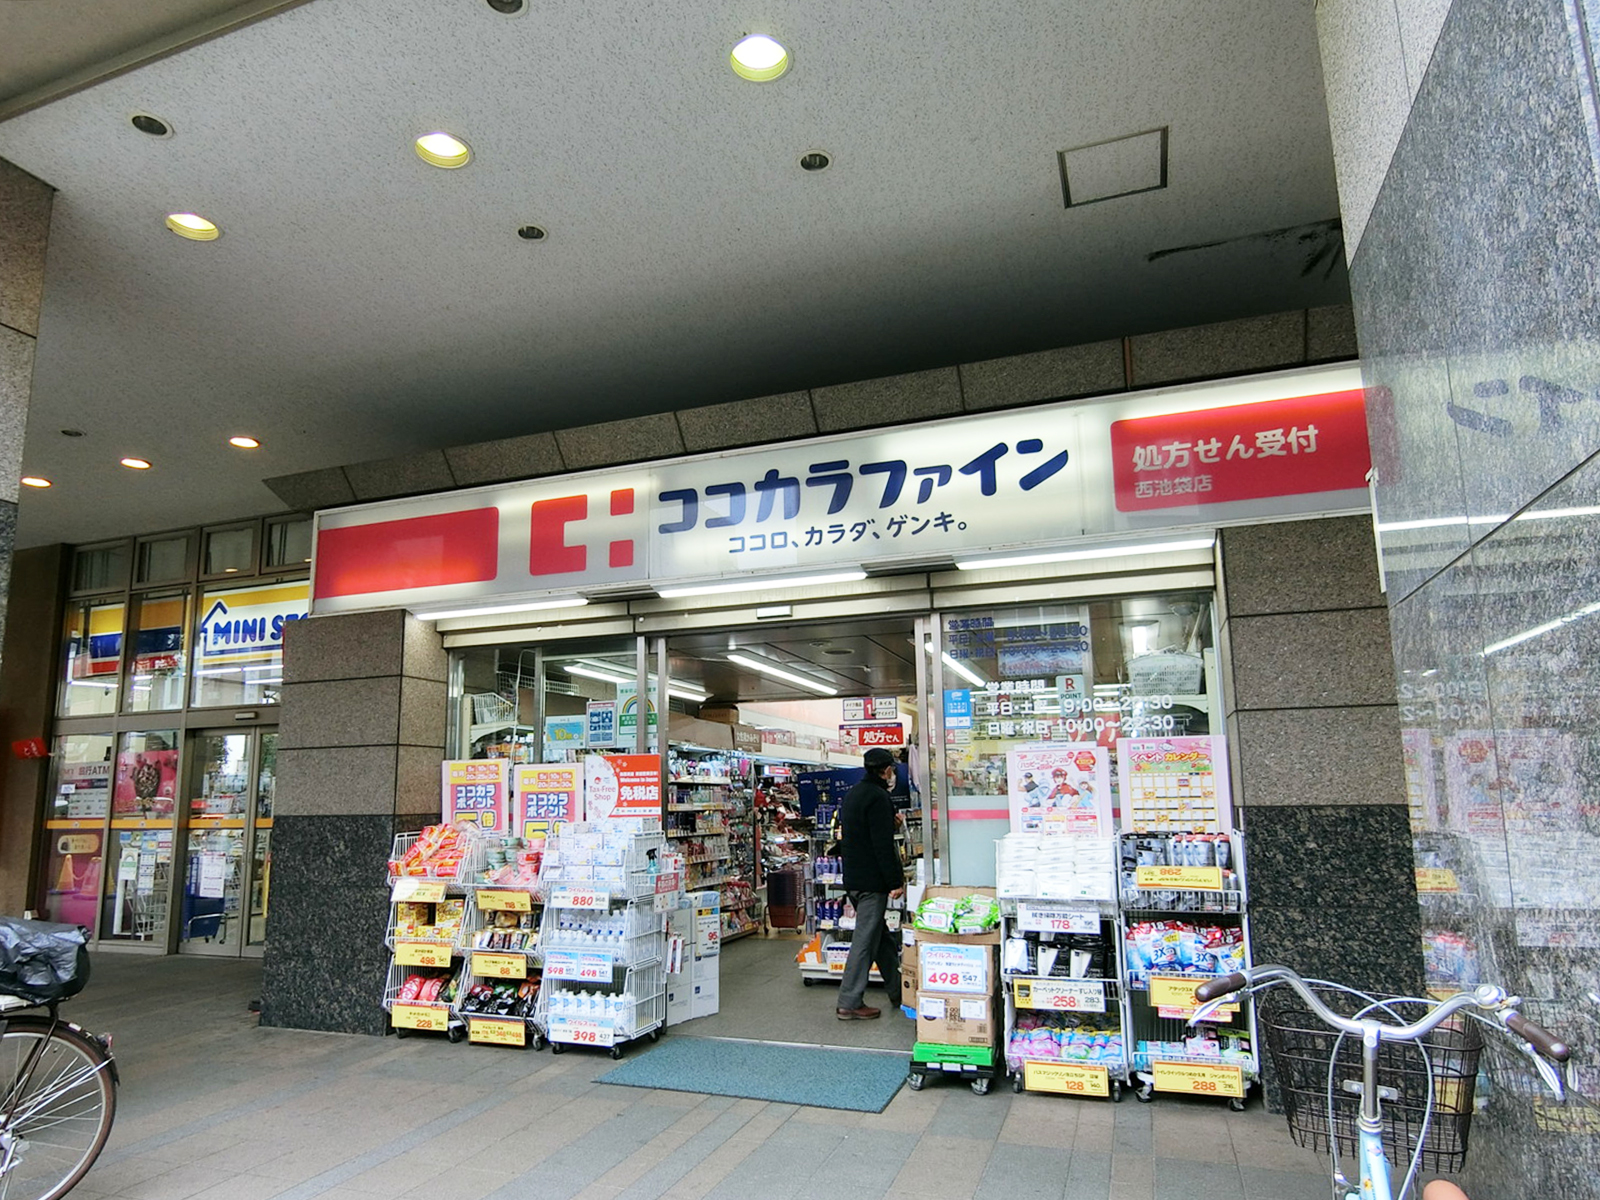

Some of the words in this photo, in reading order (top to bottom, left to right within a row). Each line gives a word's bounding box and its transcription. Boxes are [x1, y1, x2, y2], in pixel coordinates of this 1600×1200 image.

[1132, 425, 1318, 472] 処方せん受付
[658, 438, 1069, 534] ココカラファイン
[1135, 475, 1213, 498] 西池袋店
[728, 511, 967, 553] ココロ、カラダ、ゲンキ。
[213, 617, 256, 645] MINI
[985, 680, 1046, 695] 営業時間
[1065, 678, 1075, 690] R
[863, 730, 899, 743] 処方せん
[1132, 752, 1162, 762] イベント
[1164, 751, 1207, 761] カレンダー
[456, 784, 496, 797] ココカラ
[620, 785, 659, 801] 免税店
[456, 797, 495, 809] ポイント
[527, 793, 569, 806] ココカラ
[527, 806, 568, 818] ポイント
[572, 896, 594, 906] 880
[1051, 920, 1070, 930] 178
[1151, 921, 1165, 930] 18
[1153, 947, 1166, 961] 3X
[1194, 952, 1208, 963] 3X
[419, 956, 436, 965] 498
[500, 966, 510, 975] 88
[547, 966, 564, 975] 598
[580, 969, 597, 977] 498
[928, 972, 959, 985] 498
[1053, 995, 1076, 1007] 258
[416, 1019, 432, 1028] 228
[573, 1030, 596, 1042] 398
[1065, 1080, 1085, 1091] 128
[1193, 1080, 1217, 1091] 288
